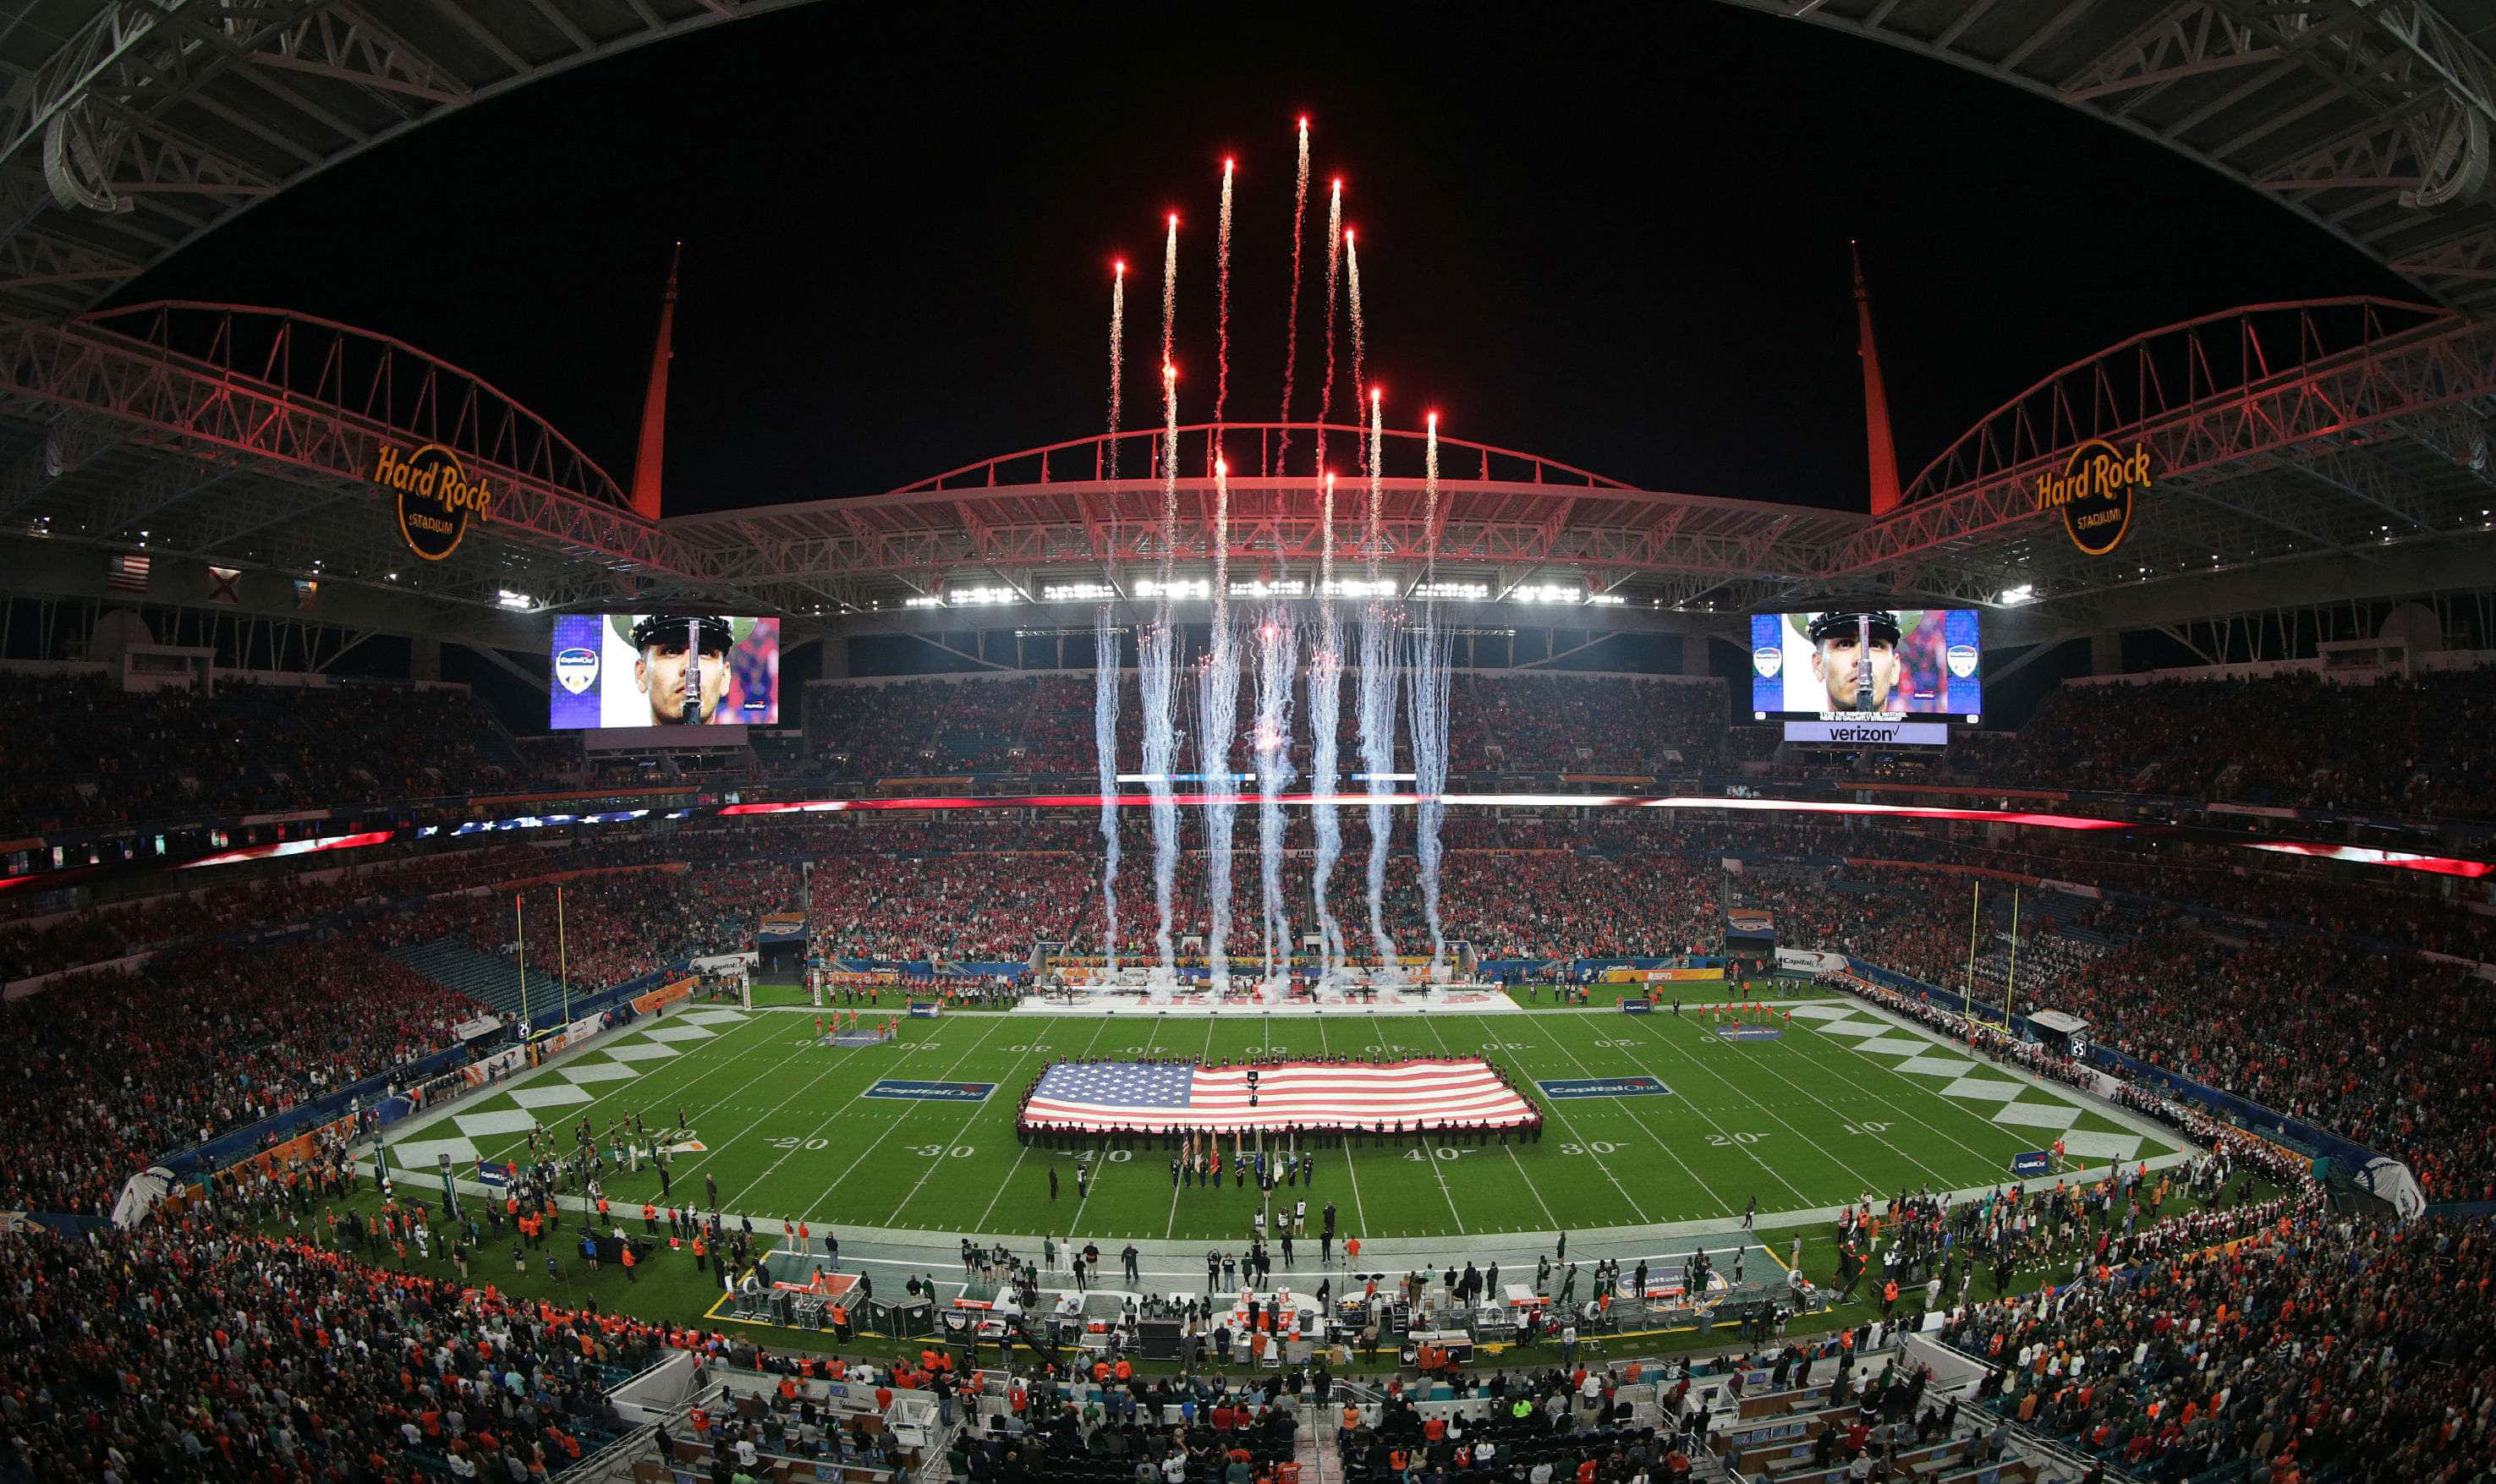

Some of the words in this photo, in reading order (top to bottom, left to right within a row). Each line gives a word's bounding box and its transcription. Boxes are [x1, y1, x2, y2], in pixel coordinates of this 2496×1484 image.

[2037, 459, 2091, 511] Hard
[2093, 441, 2152, 500] Rock
[374, 446, 439, 497] Hard
[437, 466, 491, 523] Rock
[409, 512, 453, 535] STADIUM
[2076, 508, 2121, 530] STADIUM
[1829, 725, 1893, 742] verizon
[519, 1022, 529, 1036] 25
[2073, 1040, 2084, 1056] 25
[773, 1136, 828, 1150] 20
[1559, 1141, 1616, 1155] 30
[917, 1144, 975, 1158] 30
[1073, 1149, 1133, 1163] 40
[1402, 1147, 1460, 1161] 40
